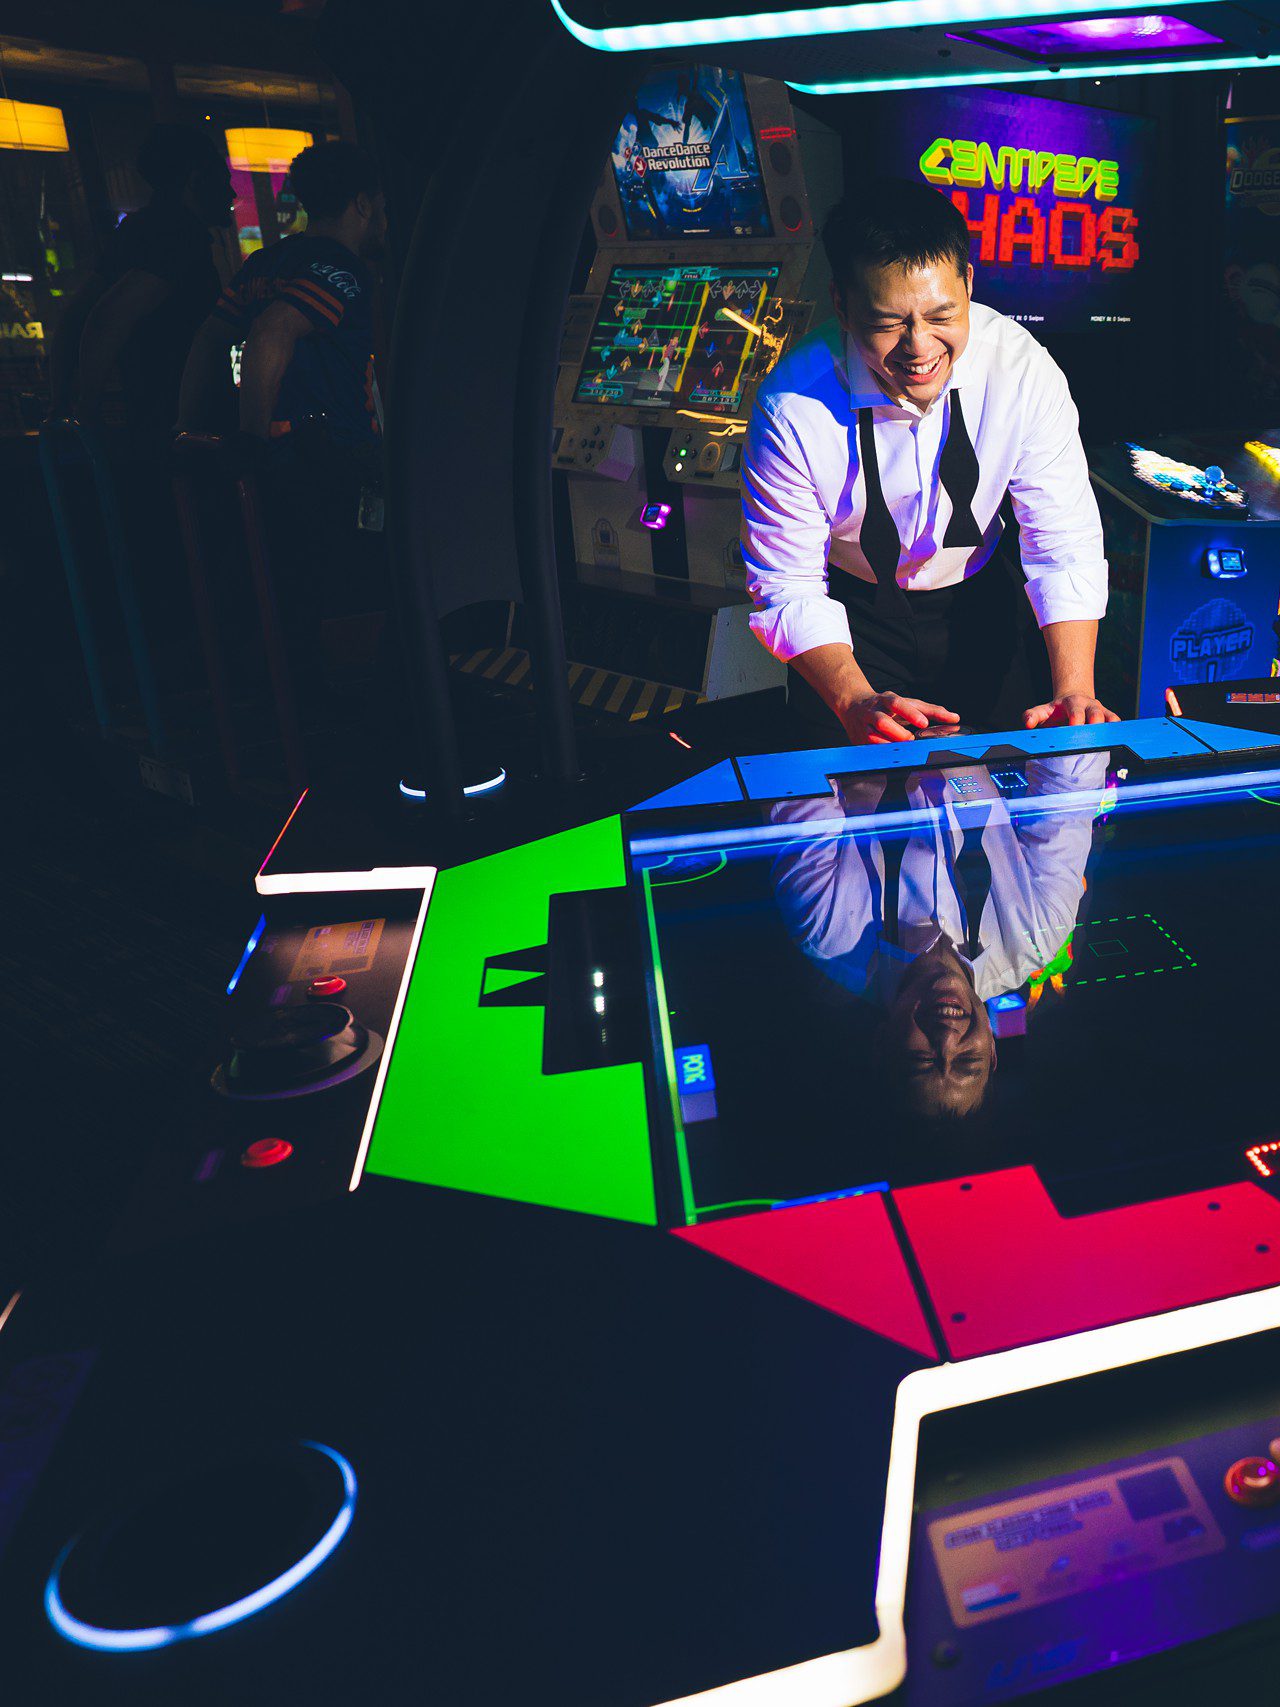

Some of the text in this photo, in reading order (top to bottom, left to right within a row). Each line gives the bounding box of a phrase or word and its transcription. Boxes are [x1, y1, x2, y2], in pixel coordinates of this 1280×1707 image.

[642, 143, 711, 158] DanceDance
[648, 155, 711, 171] Revolution
[919, 137, 1120, 202] CENTIPEDE
[935, 188, 1140, 275] HAOS
[1172, 628, 1252, 660] PLAYER
